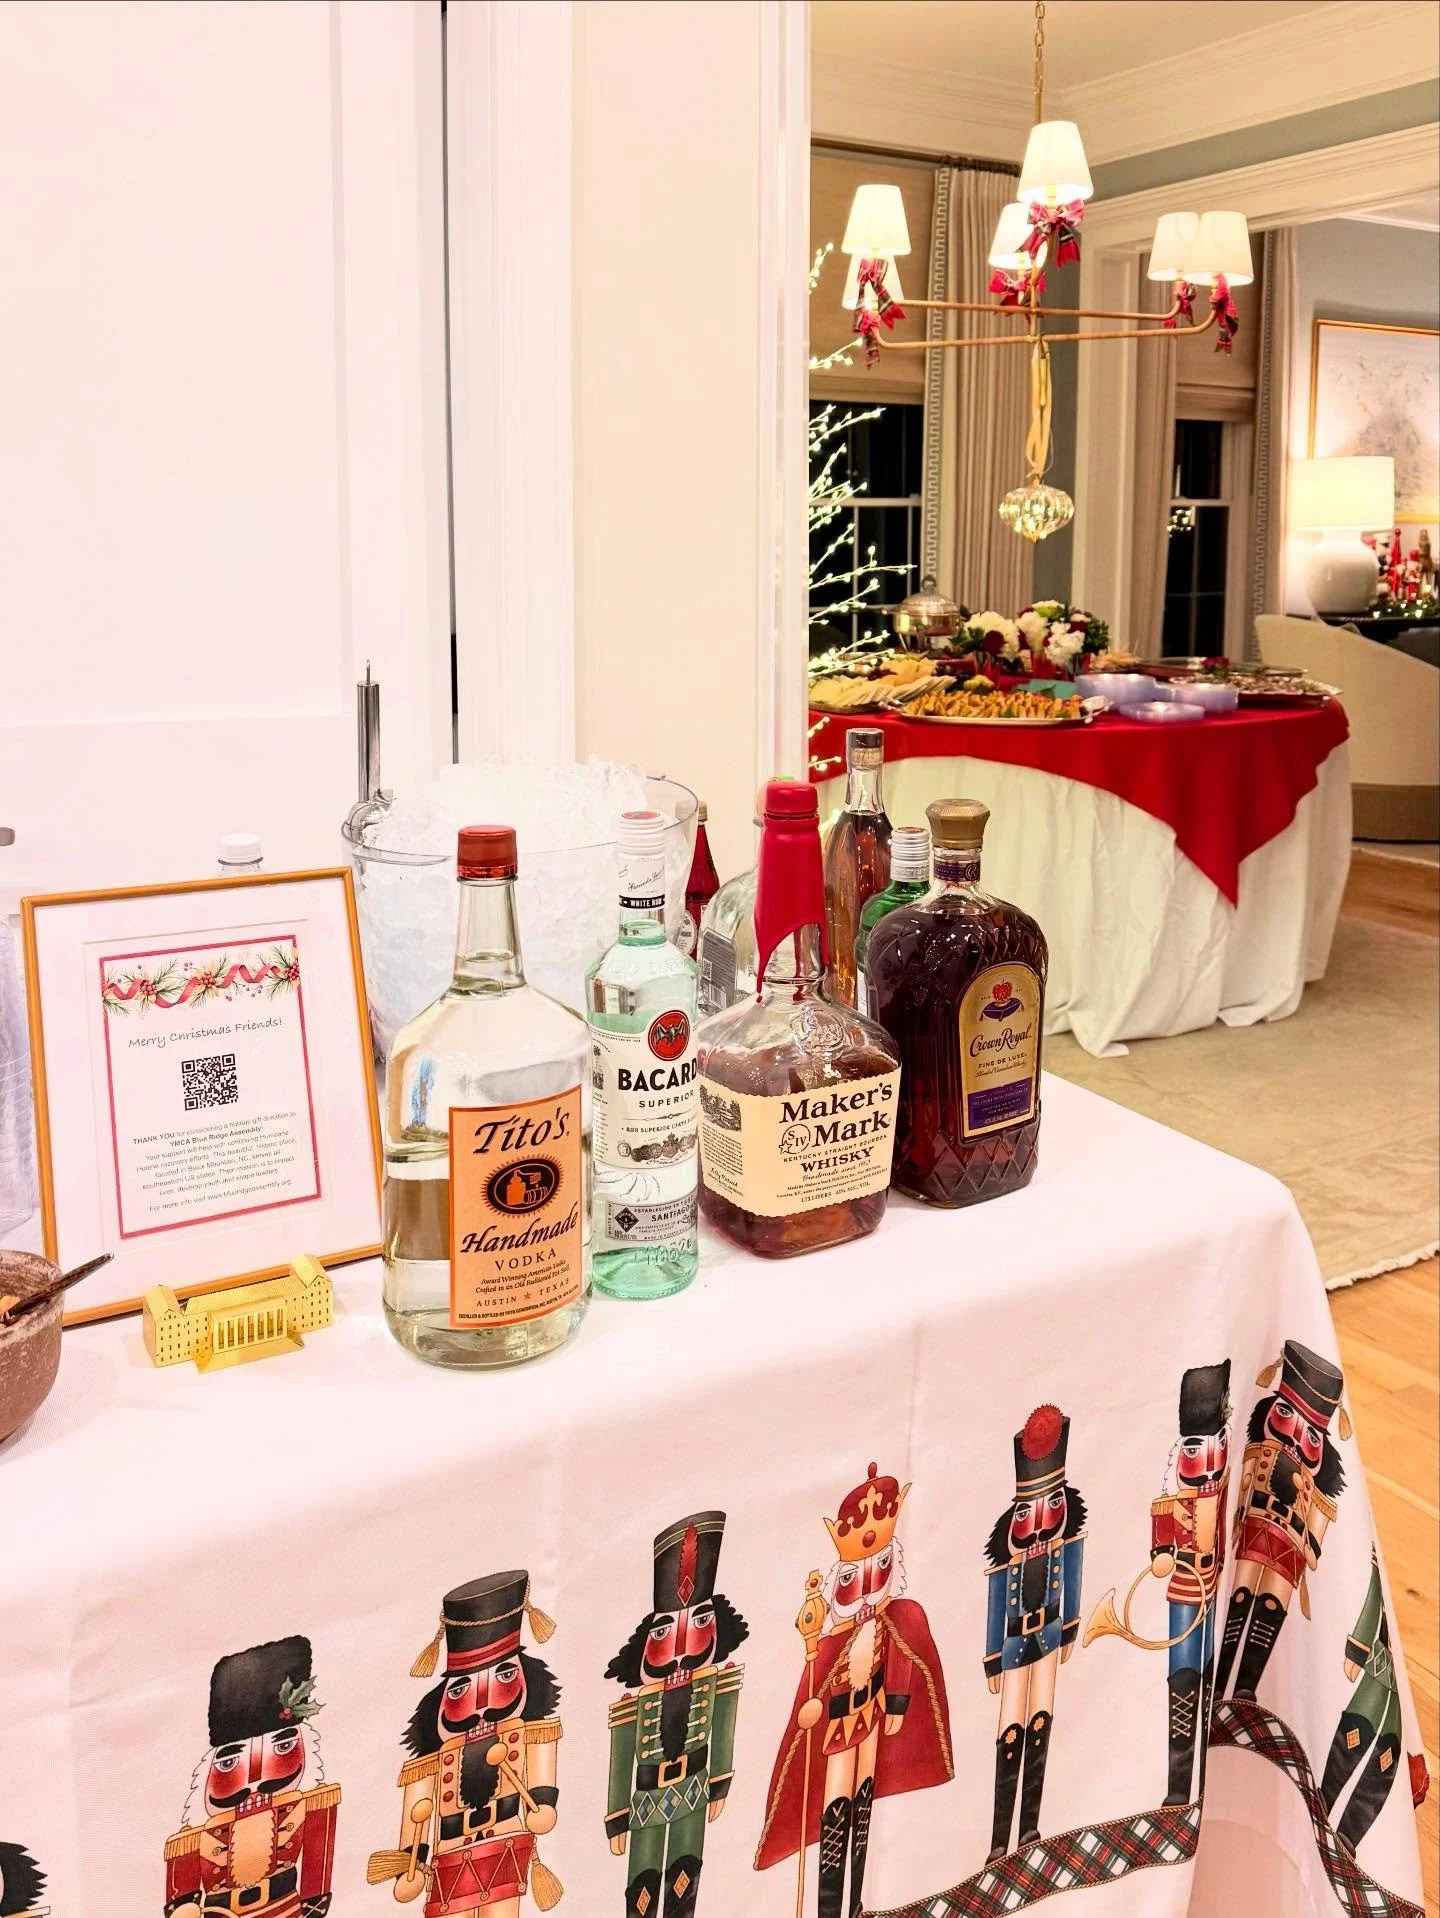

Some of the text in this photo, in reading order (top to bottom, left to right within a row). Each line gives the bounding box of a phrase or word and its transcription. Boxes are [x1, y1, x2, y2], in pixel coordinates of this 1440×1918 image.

[128, 1017, 282, 1048] Merry Christmas Friends!
[970, 1023, 1030, 1057] Crown Royal
[618, 1058, 696, 1091] BACARD
[640, 1090, 694, 1108] SUPERIOR
[779, 1083, 892, 1123] Maker's
[133, 1136, 158, 1144] THANK
[160, 1132, 174, 1140] YOU
[209, 1132, 228, 1140] Ridge
[473, 1106, 569, 1154] Tito's
[788, 1131, 795, 1140] S
[812, 1111, 890, 1147] Mark
[784, 1135, 887, 1162] KENTUCKY STRAIGHT BOURBON
[795, 1136, 806, 1146] IV
[801, 1146, 874, 1172] WHISKY
[651, 1205, 690, 1222] SANTIAGO
[460, 1201, 578, 1253] Handmade
[495, 1248, 556, 1271] VODKA
[476, 1285, 496, 1295] Crafted
[526, 1272, 551, 1285] Fashioned
[481, 1277, 500, 1285] Award
[502, 1273, 527, 1282] Winning
[528, 1266, 552, 1277] American
[539, 1278, 569, 1295] TEXAS
[476, 1296, 517, 1307] AUSTIN
